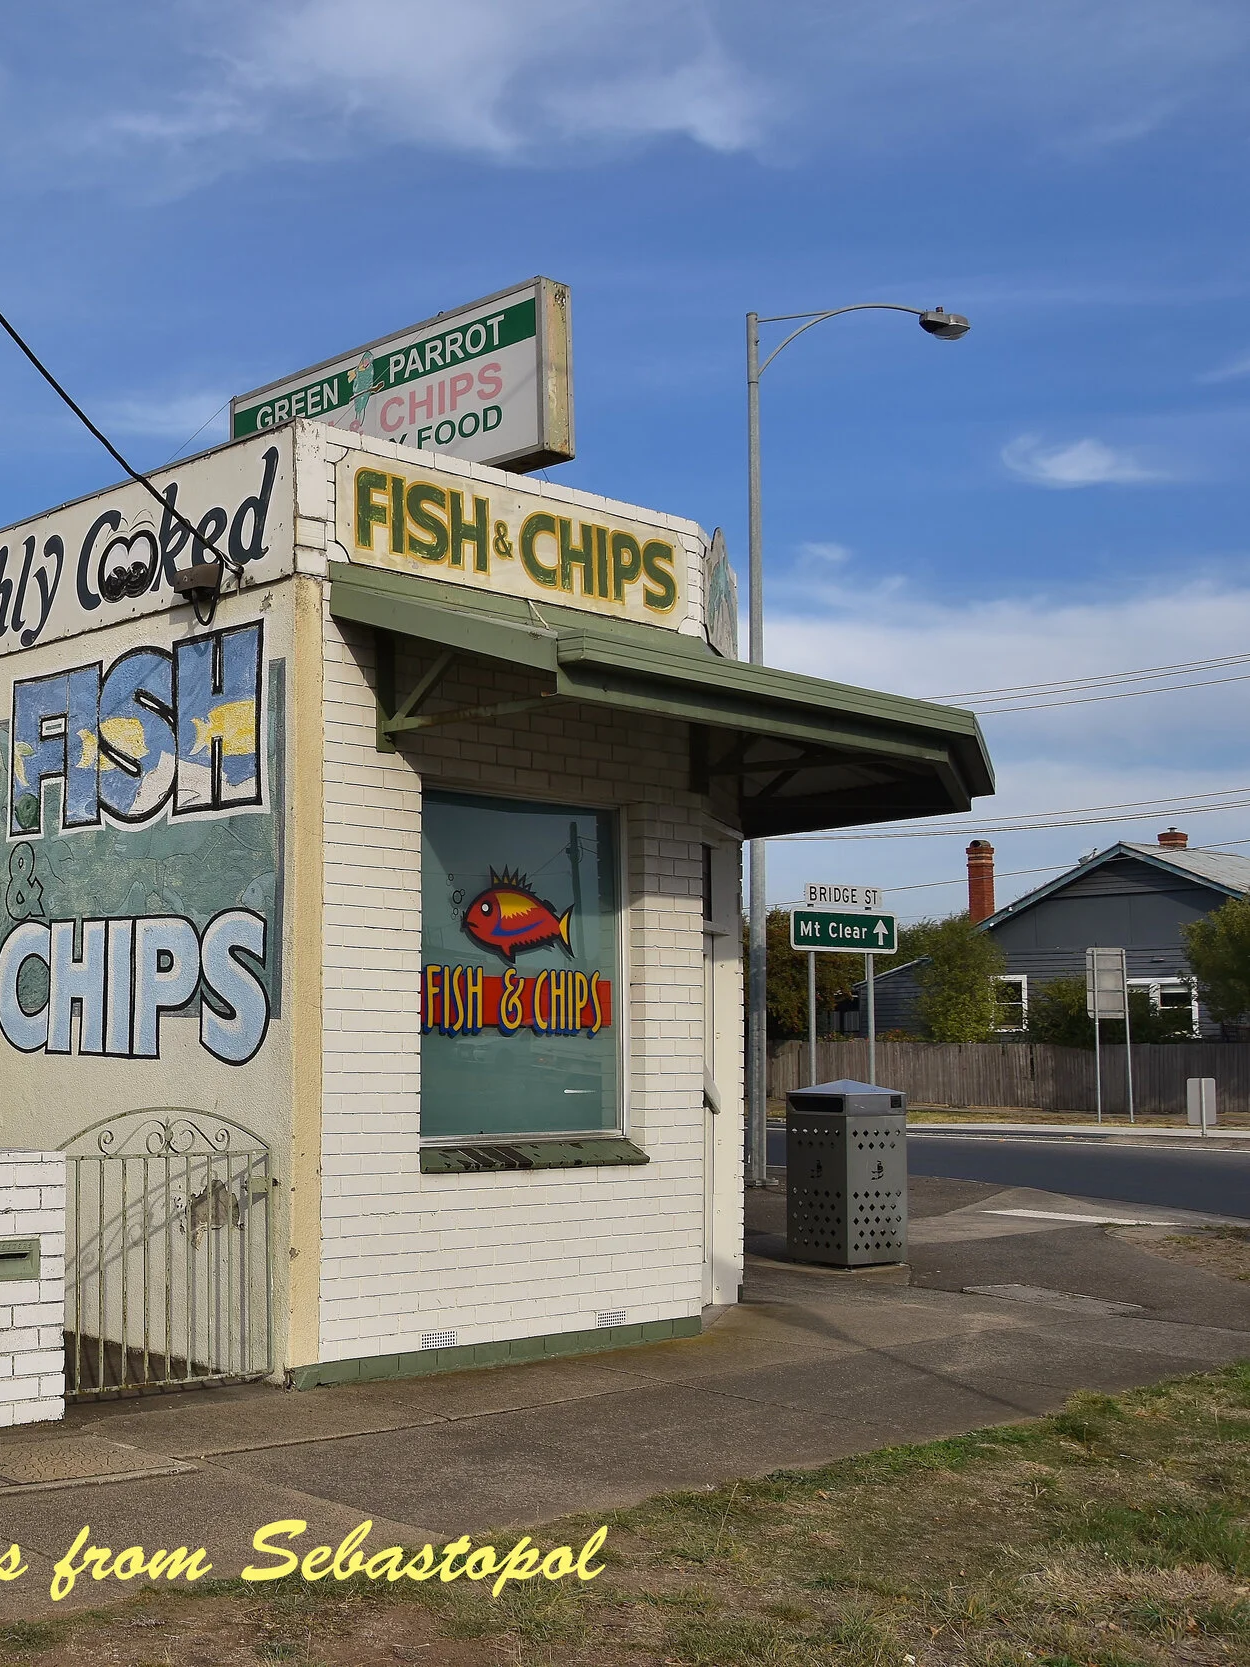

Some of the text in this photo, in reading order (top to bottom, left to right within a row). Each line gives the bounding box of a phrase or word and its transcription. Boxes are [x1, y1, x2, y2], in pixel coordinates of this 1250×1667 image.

[256, 314, 505, 430] GREEN PARROT
[380, 362, 503, 433] CHIPS
[417, 404, 503, 450] FOOD
[77, 446, 280, 611] Cooked
[353, 466, 676, 614] FISH & CHIPS
[9, 617, 266, 838] FISH
[5, 841, 45, 922] &
[809, 885, 878, 905] BRIDGE ST
[800, 920, 868, 939] Mt Clear
[424, 964, 602, 1038] FISH & CHIPS
